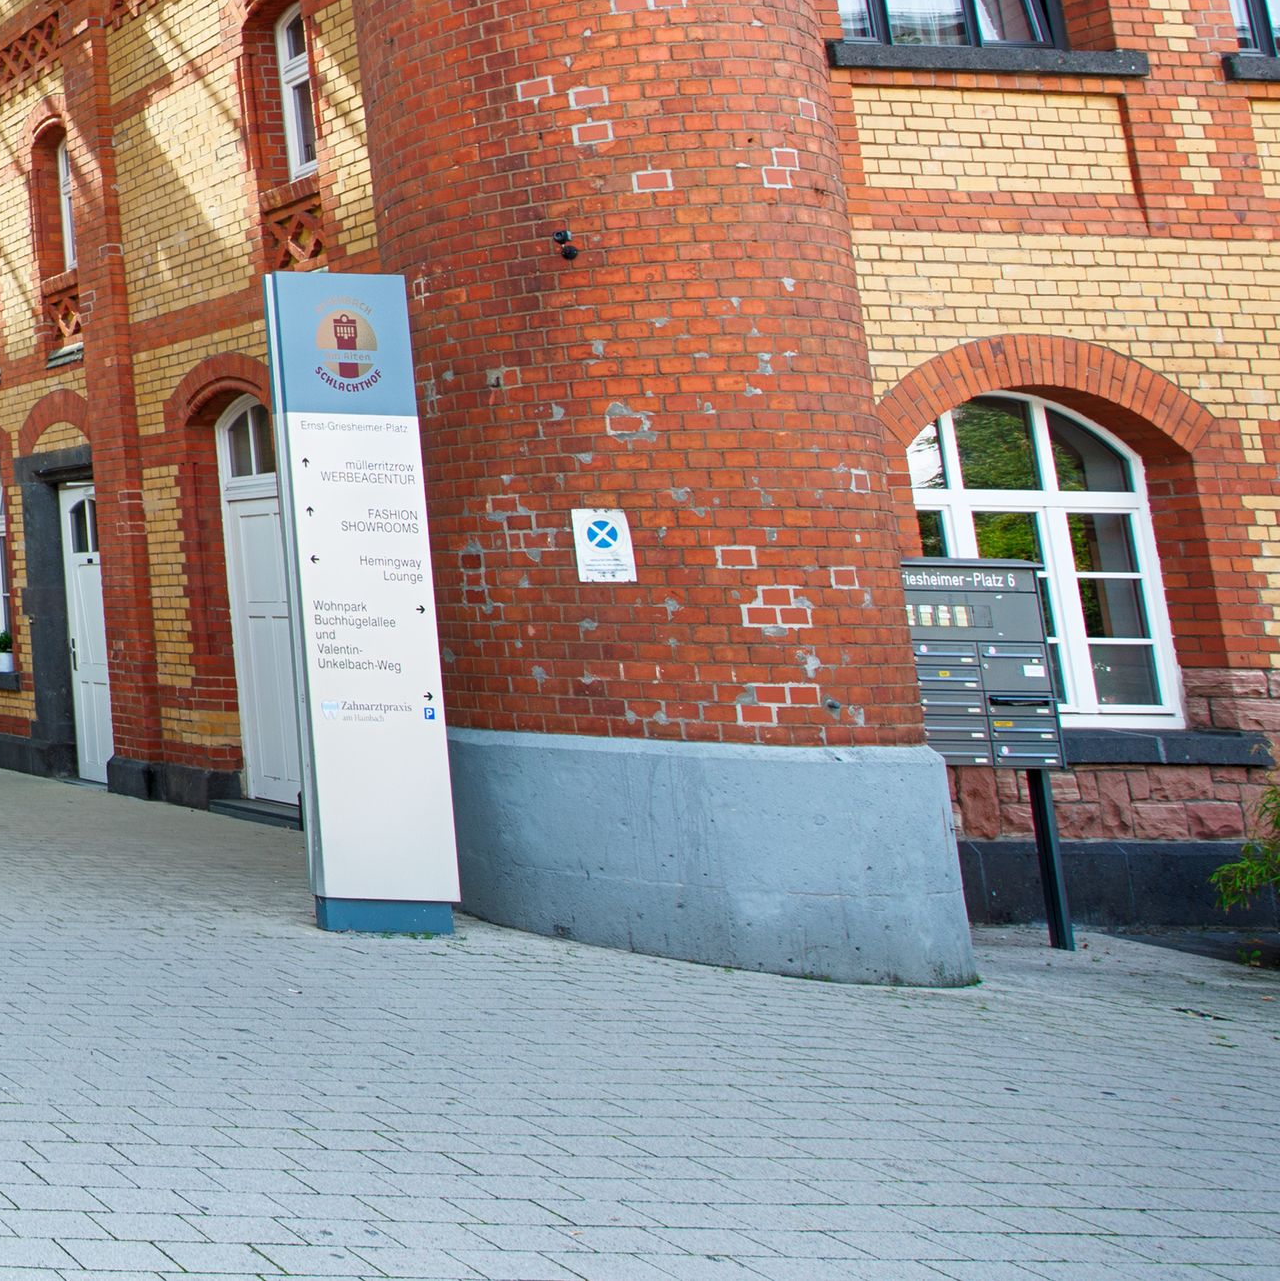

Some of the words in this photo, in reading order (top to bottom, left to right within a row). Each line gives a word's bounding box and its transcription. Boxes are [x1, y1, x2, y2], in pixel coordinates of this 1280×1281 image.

[343, 351, 372, 361] Alten
[314, 366, 382, 393] SCHLACHTHOF
[300, 420, 408, 433] Ernst-Griesheimer-Platz
[345, 460, 414, 472] müllerritzrow
[320, 471, 416, 485] WERBEAGENTUR
[367, 508, 418, 521] FASHION
[341, 520, 419, 534] SHOWROOMS
[359, 555, 422, 569] Hemingway
[383, 571, 424, 584] Lounge
[1007, 573, 1016, 587] 6
[313, 600, 367, 614] Wohnpark
[314, 614, 396, 629] Buchhügelallee
[315, 629, 336, 640] und
[317, 643, 363, 655] Valentin-
[317, 658, 402, 674] Unkelbach-Weg
[341, 701, 413, 714] Zahnarztpraxis
